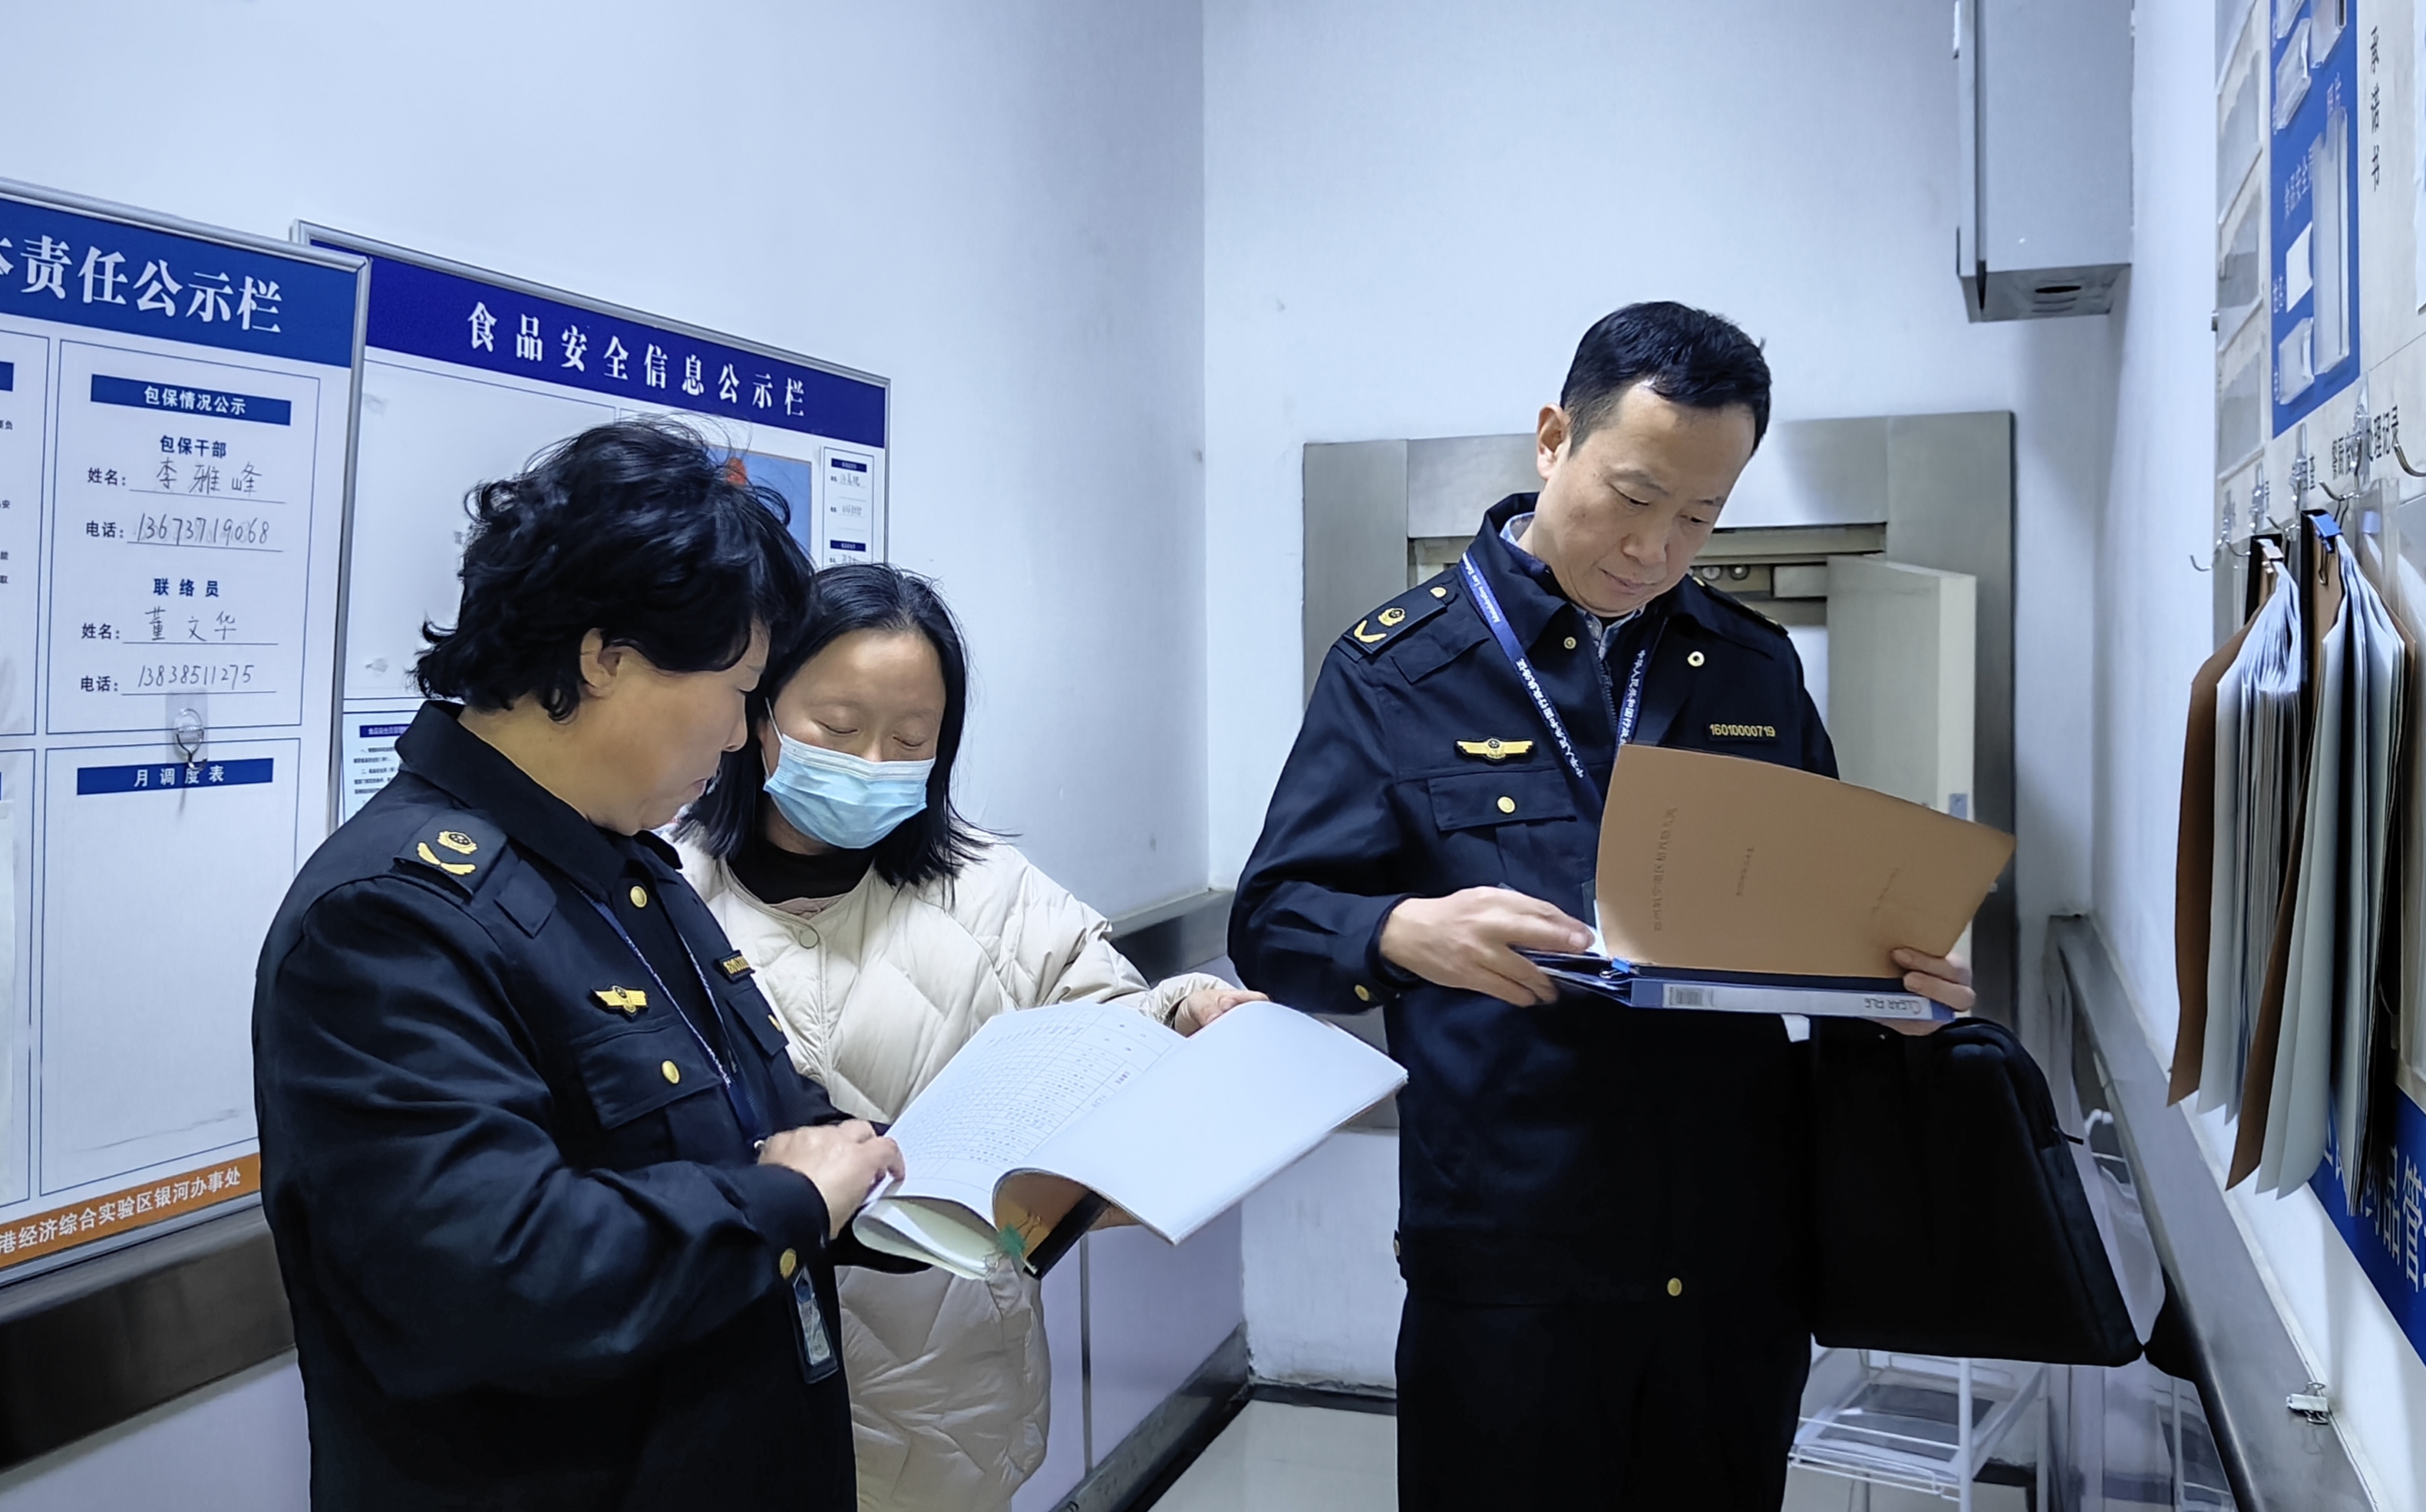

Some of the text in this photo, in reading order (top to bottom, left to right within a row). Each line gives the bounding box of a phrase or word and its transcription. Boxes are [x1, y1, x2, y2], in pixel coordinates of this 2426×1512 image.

[468, 302, 804, 417] 食品安全信息公示栏
[144, 386, 246, 415] 包保情况公示
[160, 435, 227, 459] 包保干部
[87, 467, 126, 486] 姓名：
[157, 457, 262, 496] 李雅峰
[86, 521, 124, 538] 电话：
[153, 579, 219, 597] 联络员
[81, 623, 120, 639] 姓名：
[145, 606, 236, 642] 董文华
[81, 676, 118, 692] 电话：
[138, 665, 254, 690] 13838511275
[1516, 658, 1584, 778] 中华人民共和国行政执法证
[1709, 724, 1776, 737] 16010000719
[134, 765, 225, 787] 月调度表
[0, 1167, 241, 1255] 港经济综合实验区银河办事处
